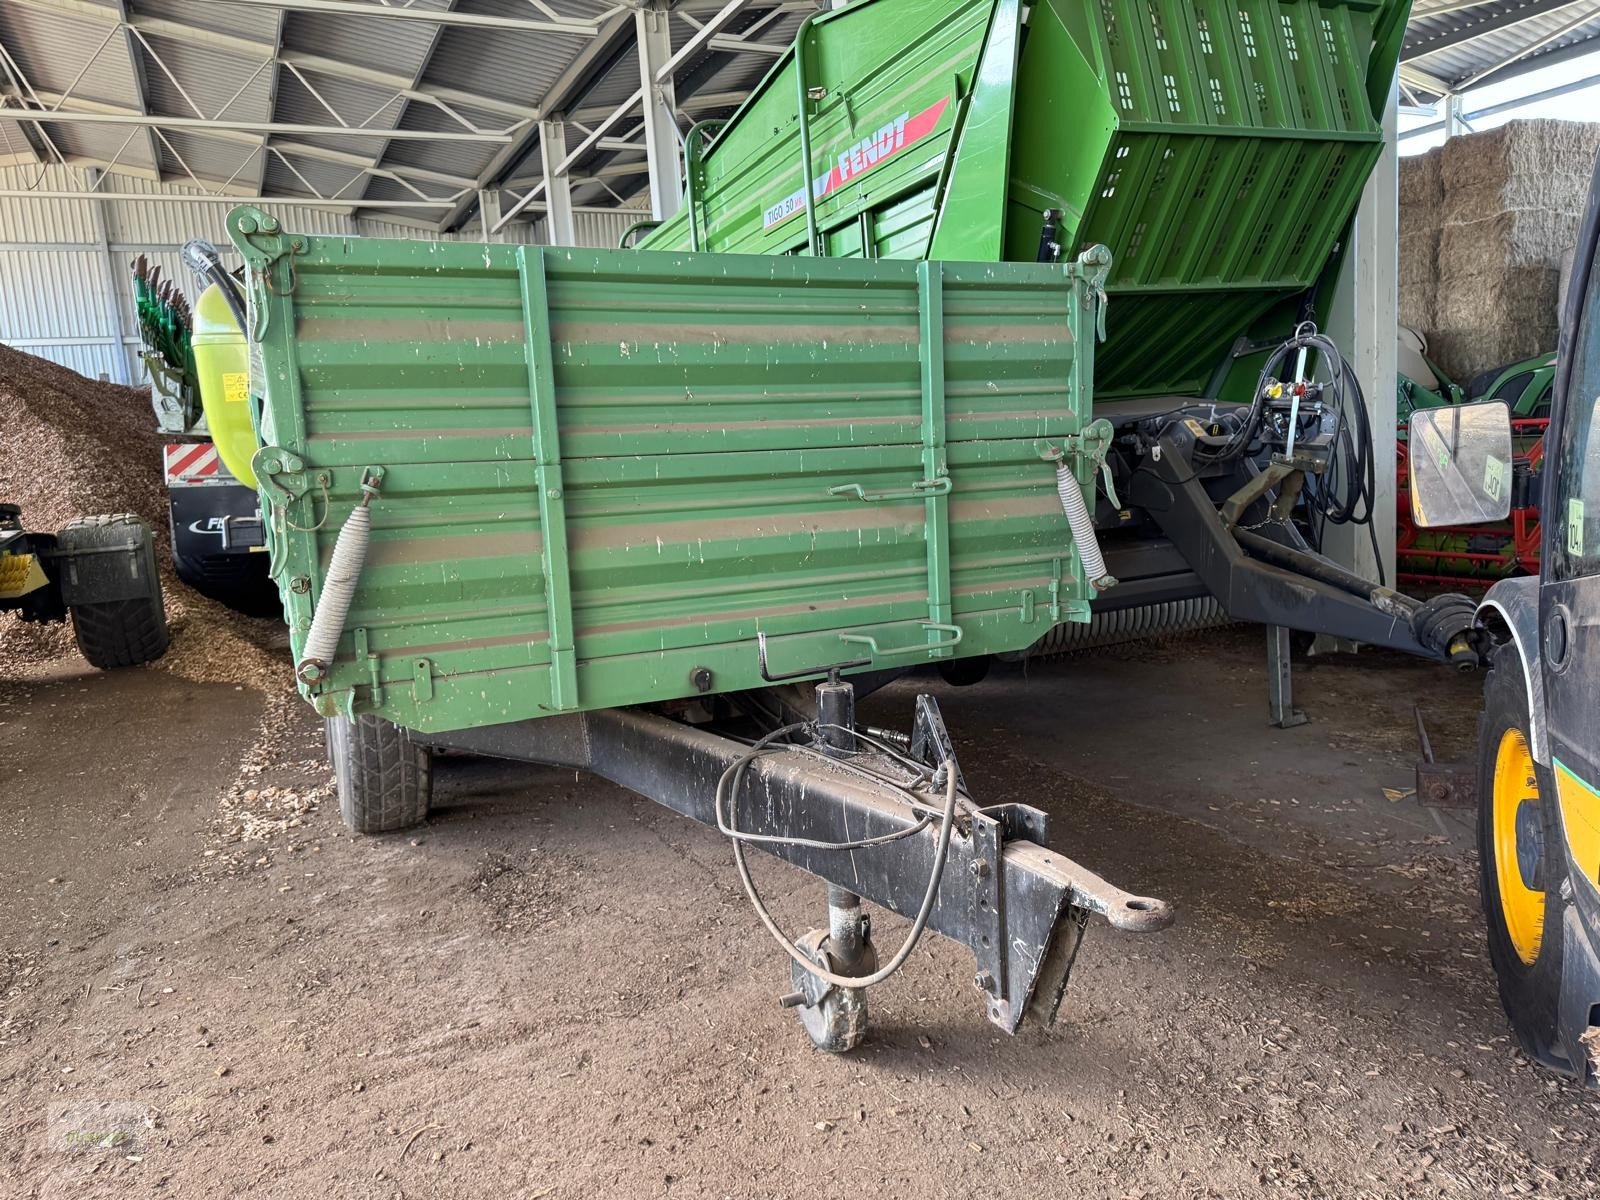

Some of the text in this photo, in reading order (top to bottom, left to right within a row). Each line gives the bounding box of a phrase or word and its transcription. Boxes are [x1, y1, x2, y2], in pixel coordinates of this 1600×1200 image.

[837, 110, 910, 181] FENDT
[768, 205, 784, 225] TIGO
[785, 198, 794, 214] 50
